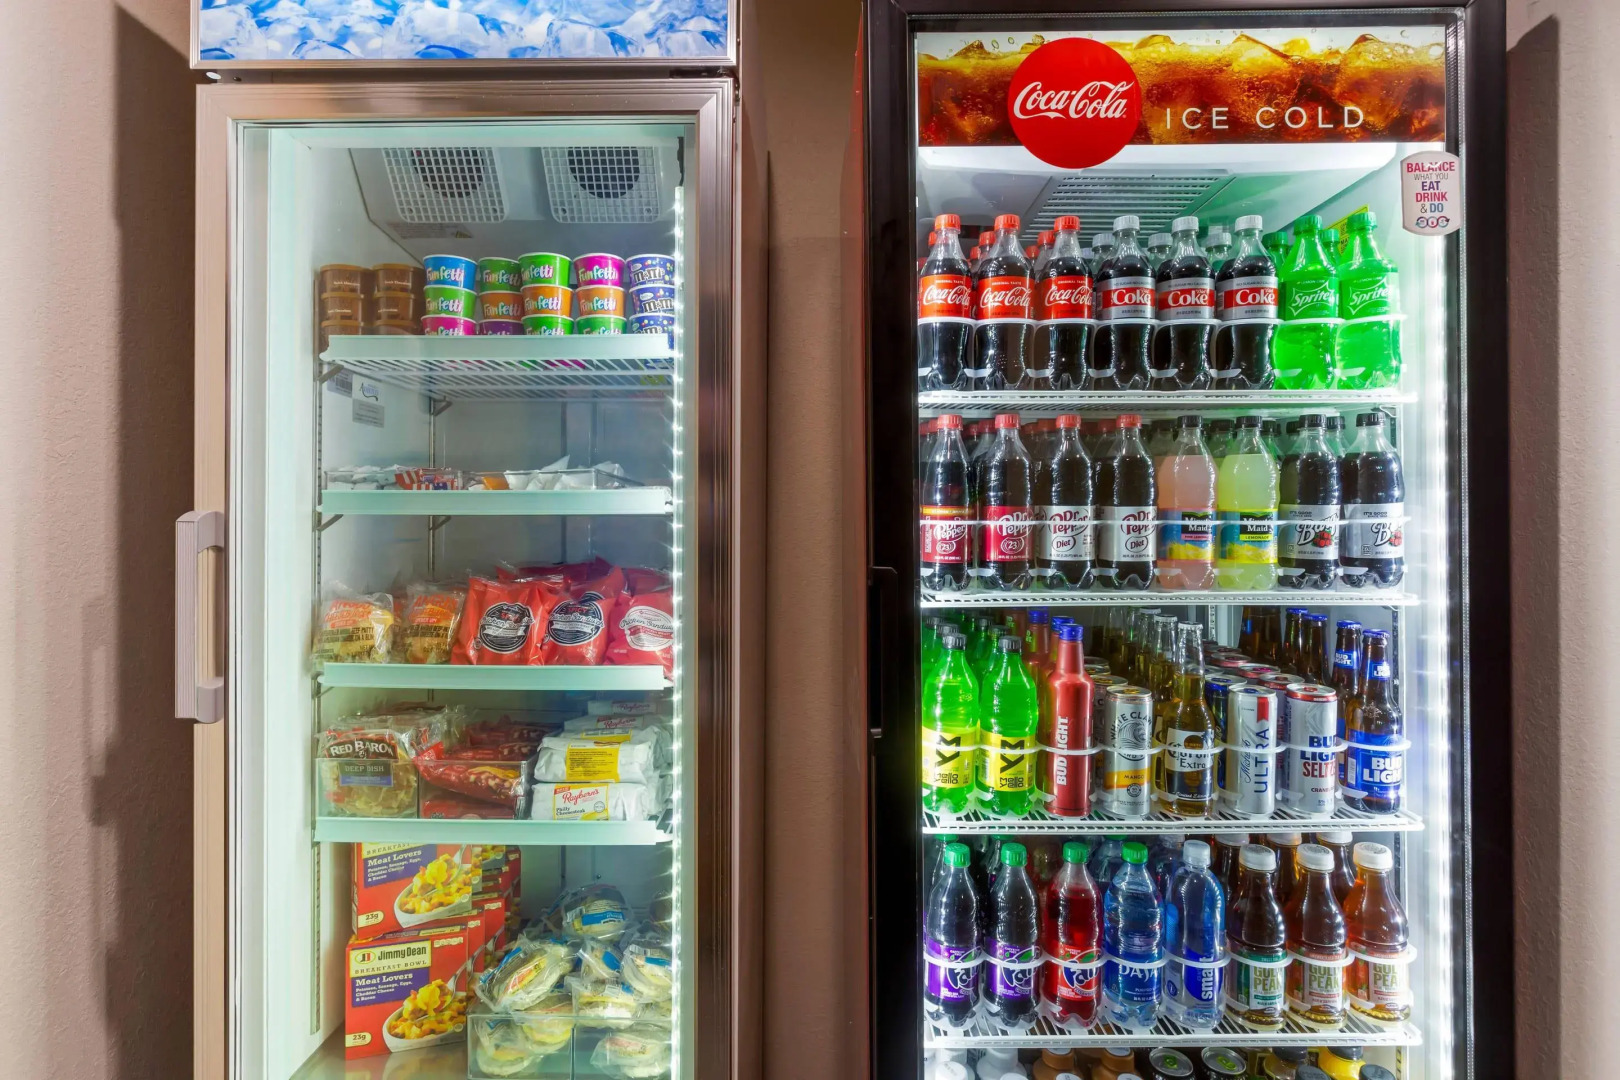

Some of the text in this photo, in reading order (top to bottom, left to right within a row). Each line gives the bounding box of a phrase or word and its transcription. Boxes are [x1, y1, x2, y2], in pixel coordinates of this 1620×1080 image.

[1013, 81, 1135, 120] Coca-Cola
[1166, 106, 1364, 129] ICE COLD
[1406, 162, 1456, 173] BALANCE
[1413, 172, 1449, 181] WHAT YOU
[1415, 192, 1449, 203] DRINK
[1420, 203, 1444, 214] & DO
[426, 265, 465, 283] Funfetti
[578, 265, 618, 284] Funfetti
[922, 285, 971, 306] Coca-Cola
[980, 286, 1032, 308] Coca-Cola
[1046, 285, 1093, 307] Coca-Cola
[1113, 289, 1152, 305] Coke
[1168, 290, 1209, 306] Coke
[1236, 289, 1275, 305] Coke
[1291, 289, 1331, 307] Sprite
[1350, 286, 1388, 306] Sprite
[425, 296, 464, 313] Funfetti
[579, 296, 617, 313] Funfetti
[1188, 524, 1208, 532] Maid
[1247, 524, 1268, 532] Maid
[1008, 541, 1018, 550] 23
[1056, 539, 1071, 549] Diet
[1130, 540, 1145, 549] Diet
[330, 738, 394, 758] RED BARON
[1179, 757, 1207, 769] Extra
[1254, 727, 1270, 794] ULTRA
[344, 765, 385, 773] DEEP DISH
[1056, 756, 1068, 786] BUD
[368, 850, 422, 868] Meat Lovers
[365, 912, 379, 921] 23g
[378, 946, 427, 962] Jimmy Dean
[355, 960, 427, 977] BREAKFAST BOWL
[356, 973, 413, 987] Meat Lovers
[356, 987, 395, 998] Cheddar Cheese
[353, 1034, 367, 1043] 23g
